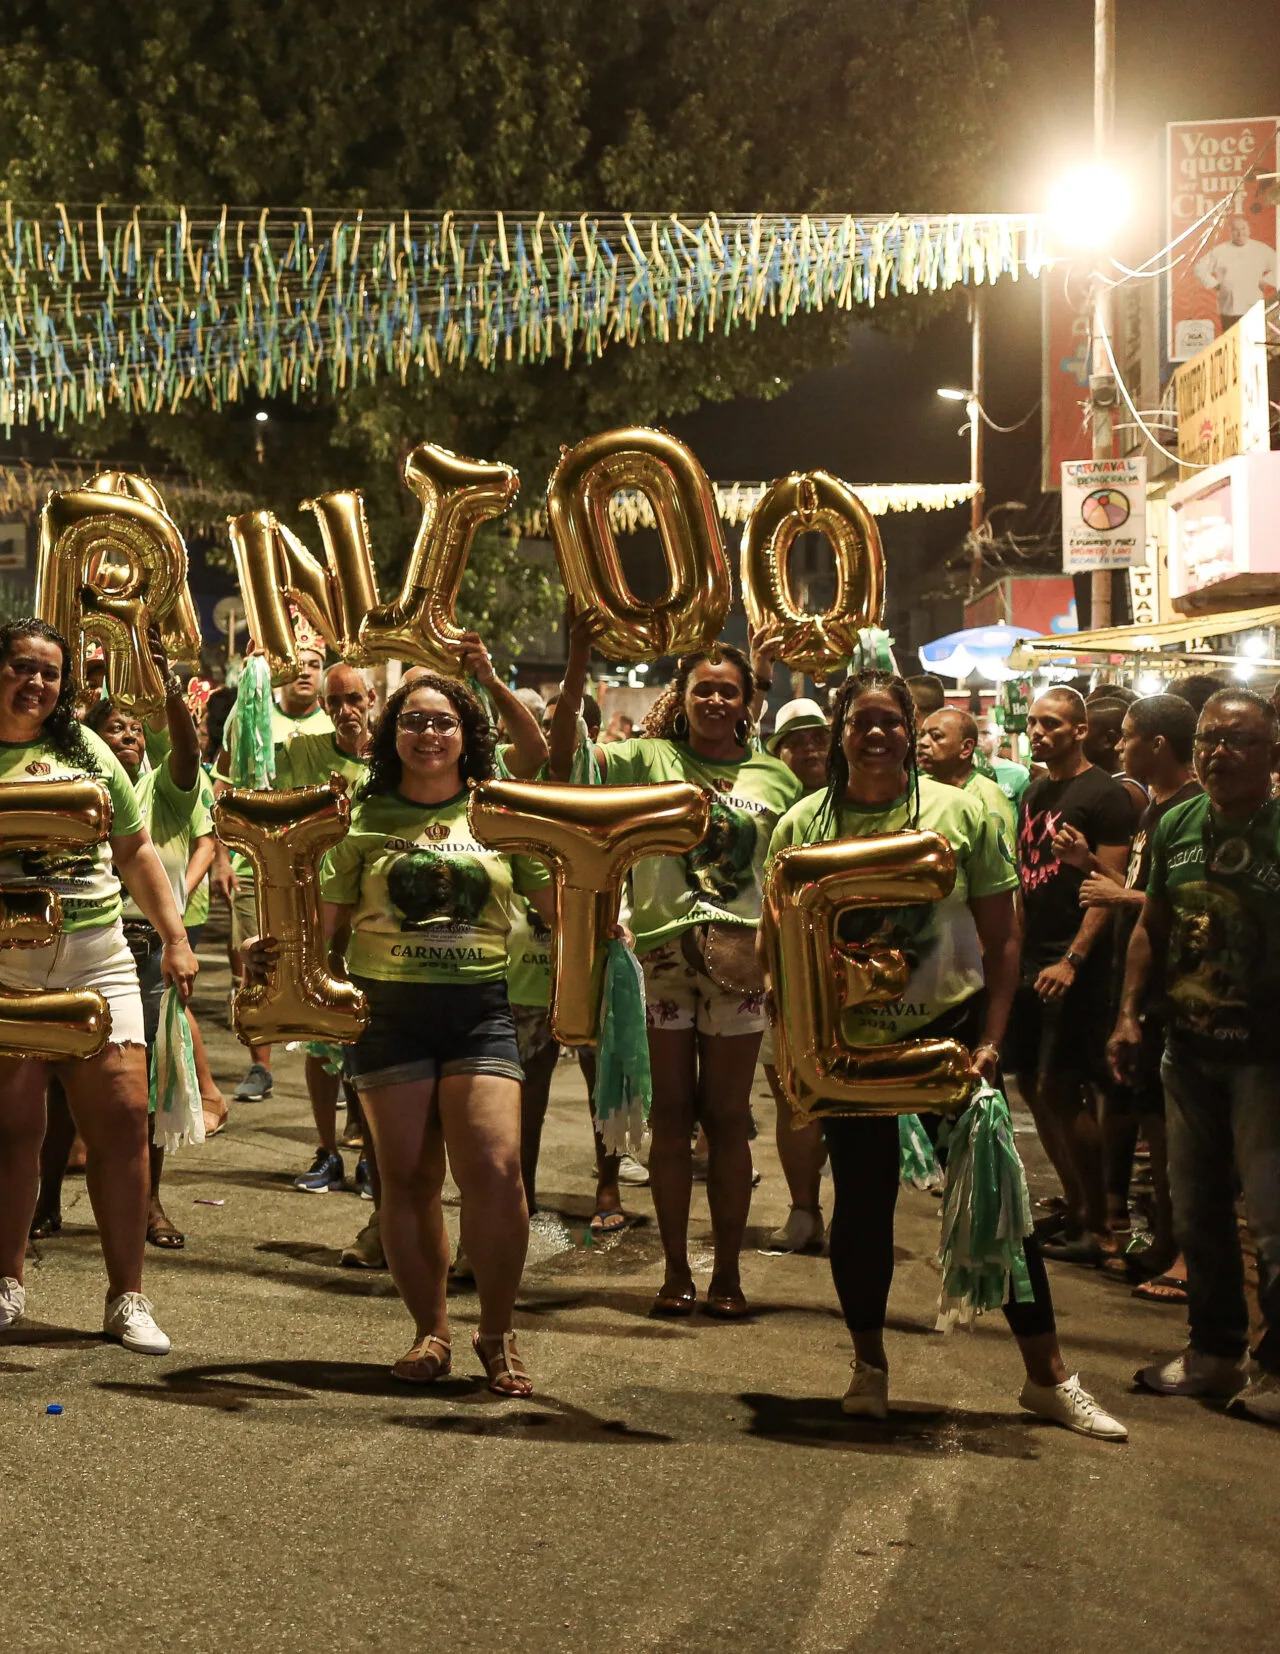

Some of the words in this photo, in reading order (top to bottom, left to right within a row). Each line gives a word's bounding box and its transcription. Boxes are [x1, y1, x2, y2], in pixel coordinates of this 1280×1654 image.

[1175, 128, 1255, 156] Você
[1180, 154, 1248, 181] quer
[1201, 175, 1245, 192] um
[1173, 191, 1248, 218] Chef
[1134, 566, 1153, 624] TUAG
[390, 944, 486, 961] CARNAVAL
[521, 953, 551, 965] CAR
